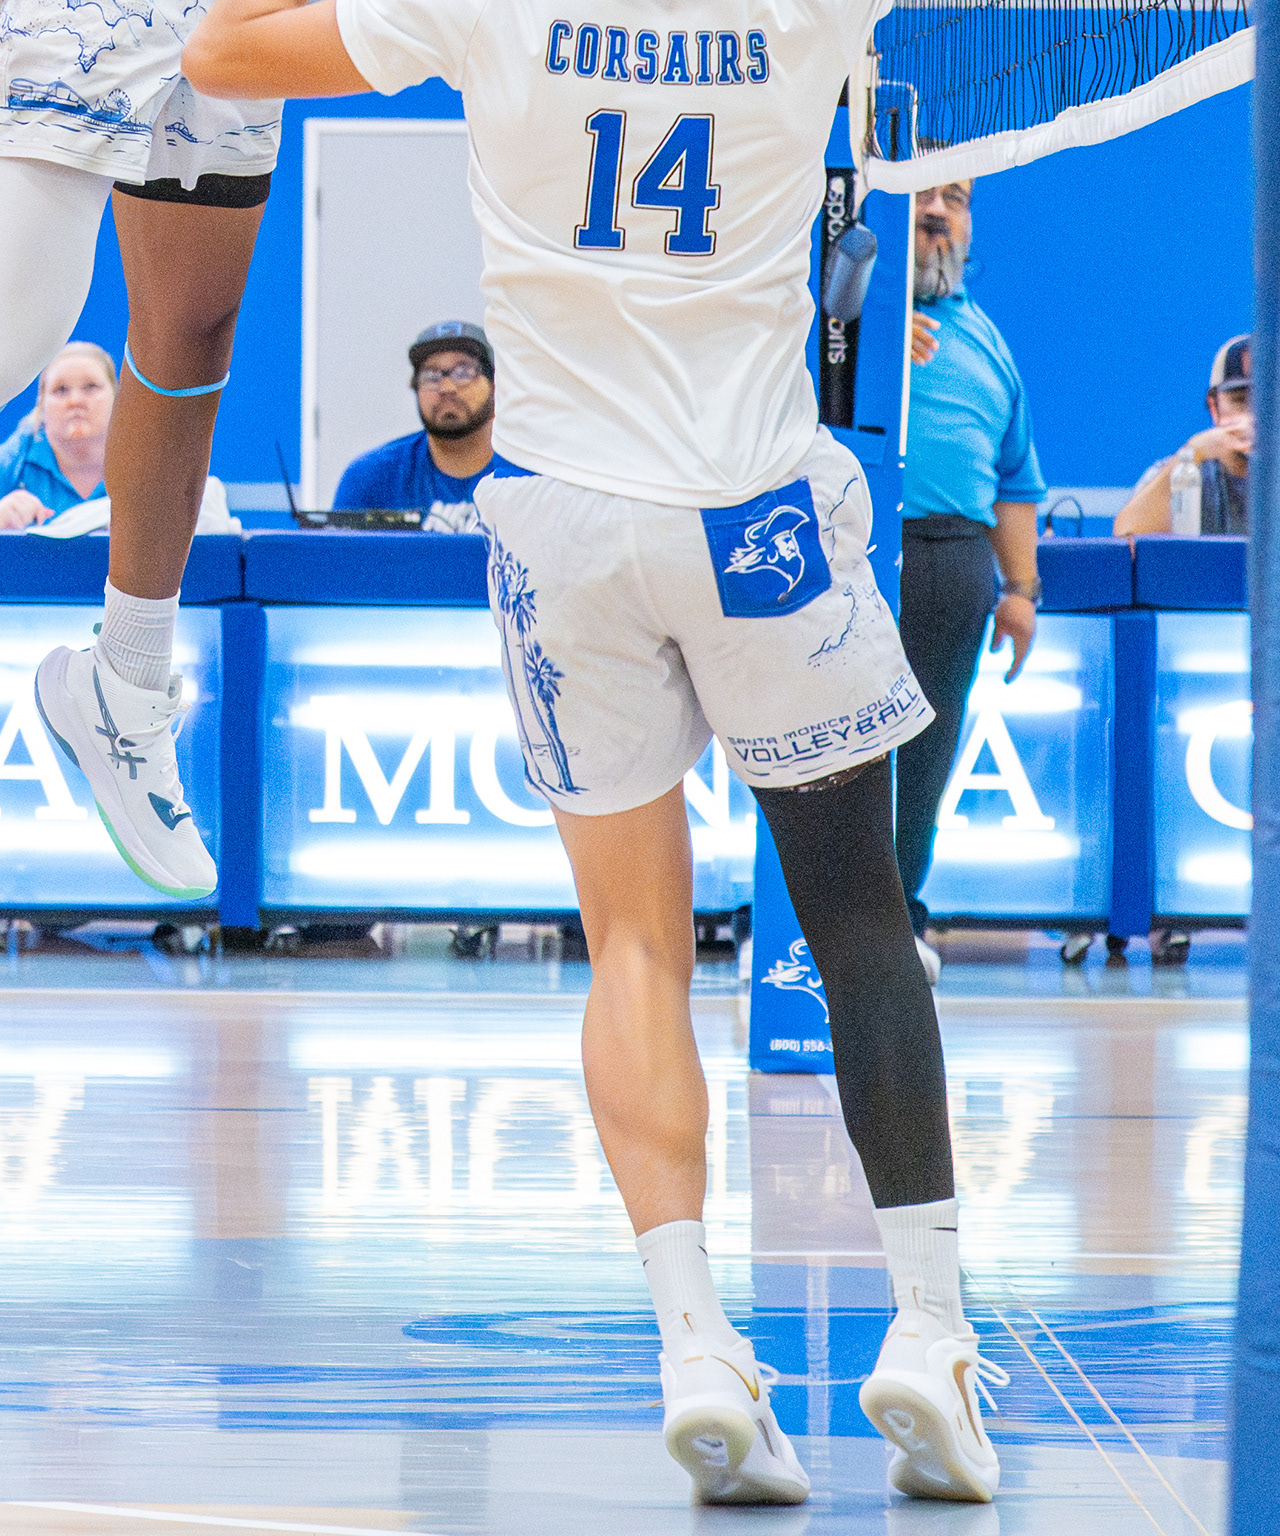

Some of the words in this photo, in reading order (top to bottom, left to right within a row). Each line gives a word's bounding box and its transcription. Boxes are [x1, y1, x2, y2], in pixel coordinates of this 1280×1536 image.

[545, 19, 770, 86] CORSAIRS
[573, 108, 720, 257] 14
[726, 735, 779, 748] SANTA
[782, 714, 852, 742] MONICA
[855, 673, 908, 719] COLLEGE
[733, 687, 919, 763] VOLLEYBALL
